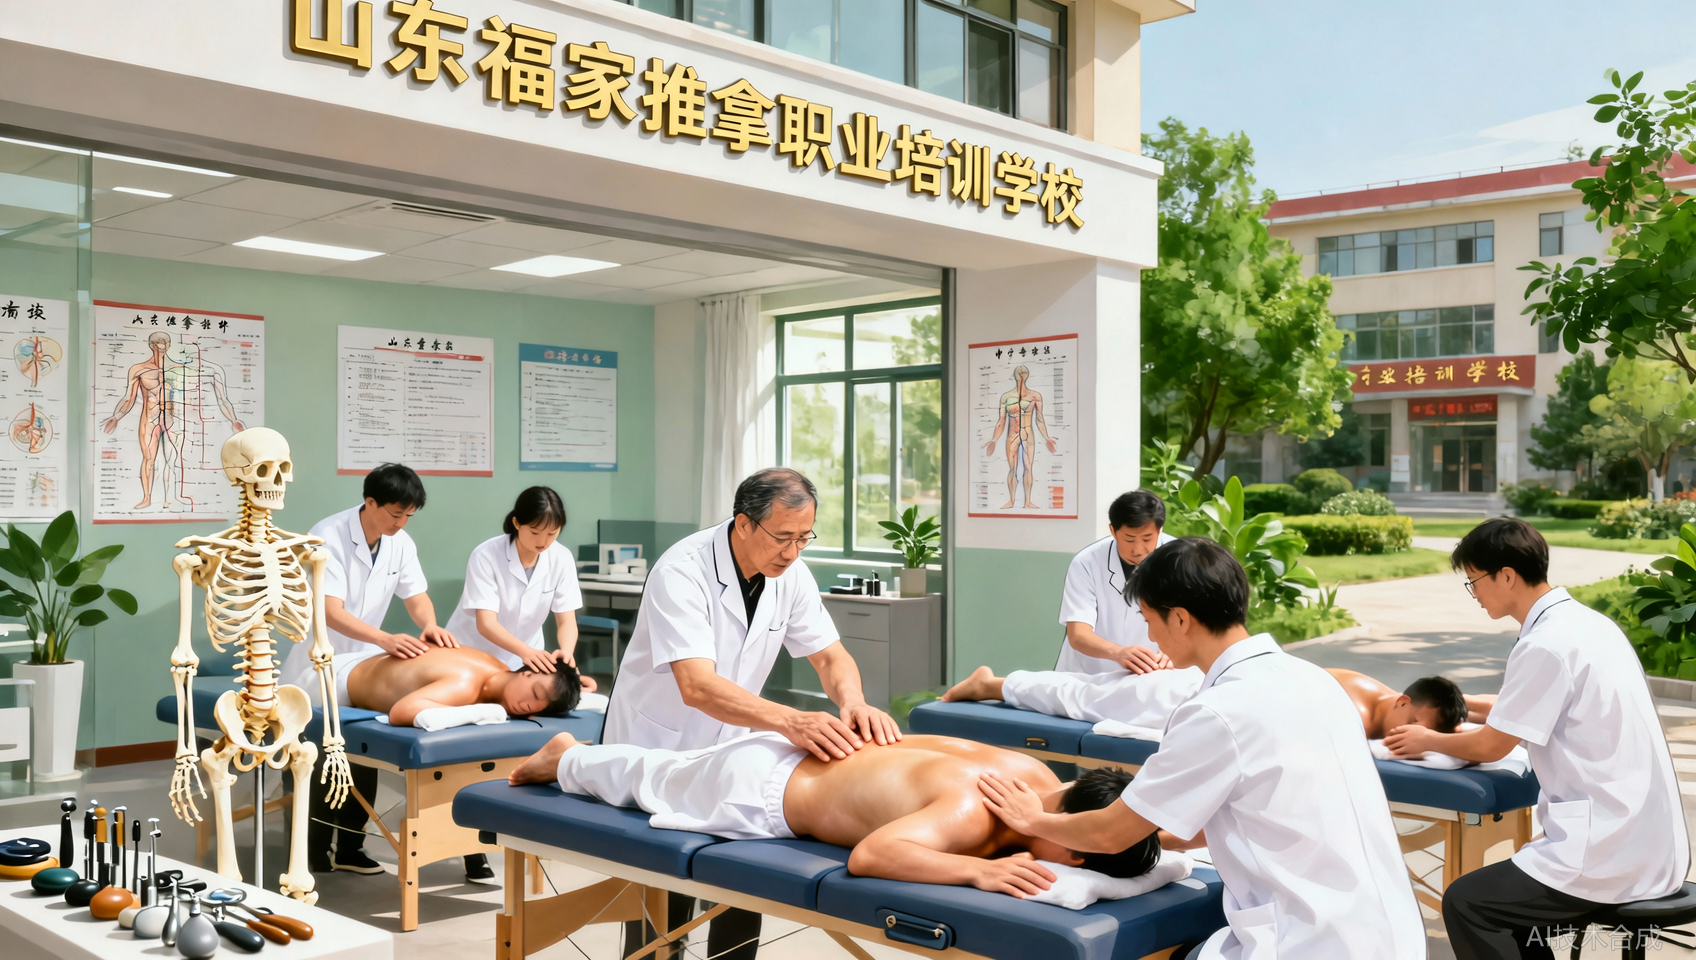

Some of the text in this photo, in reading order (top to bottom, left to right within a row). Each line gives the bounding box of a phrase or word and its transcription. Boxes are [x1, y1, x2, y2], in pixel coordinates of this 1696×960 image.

[289, 0, 1085, 230] 山东福家推拿职业培训学校
